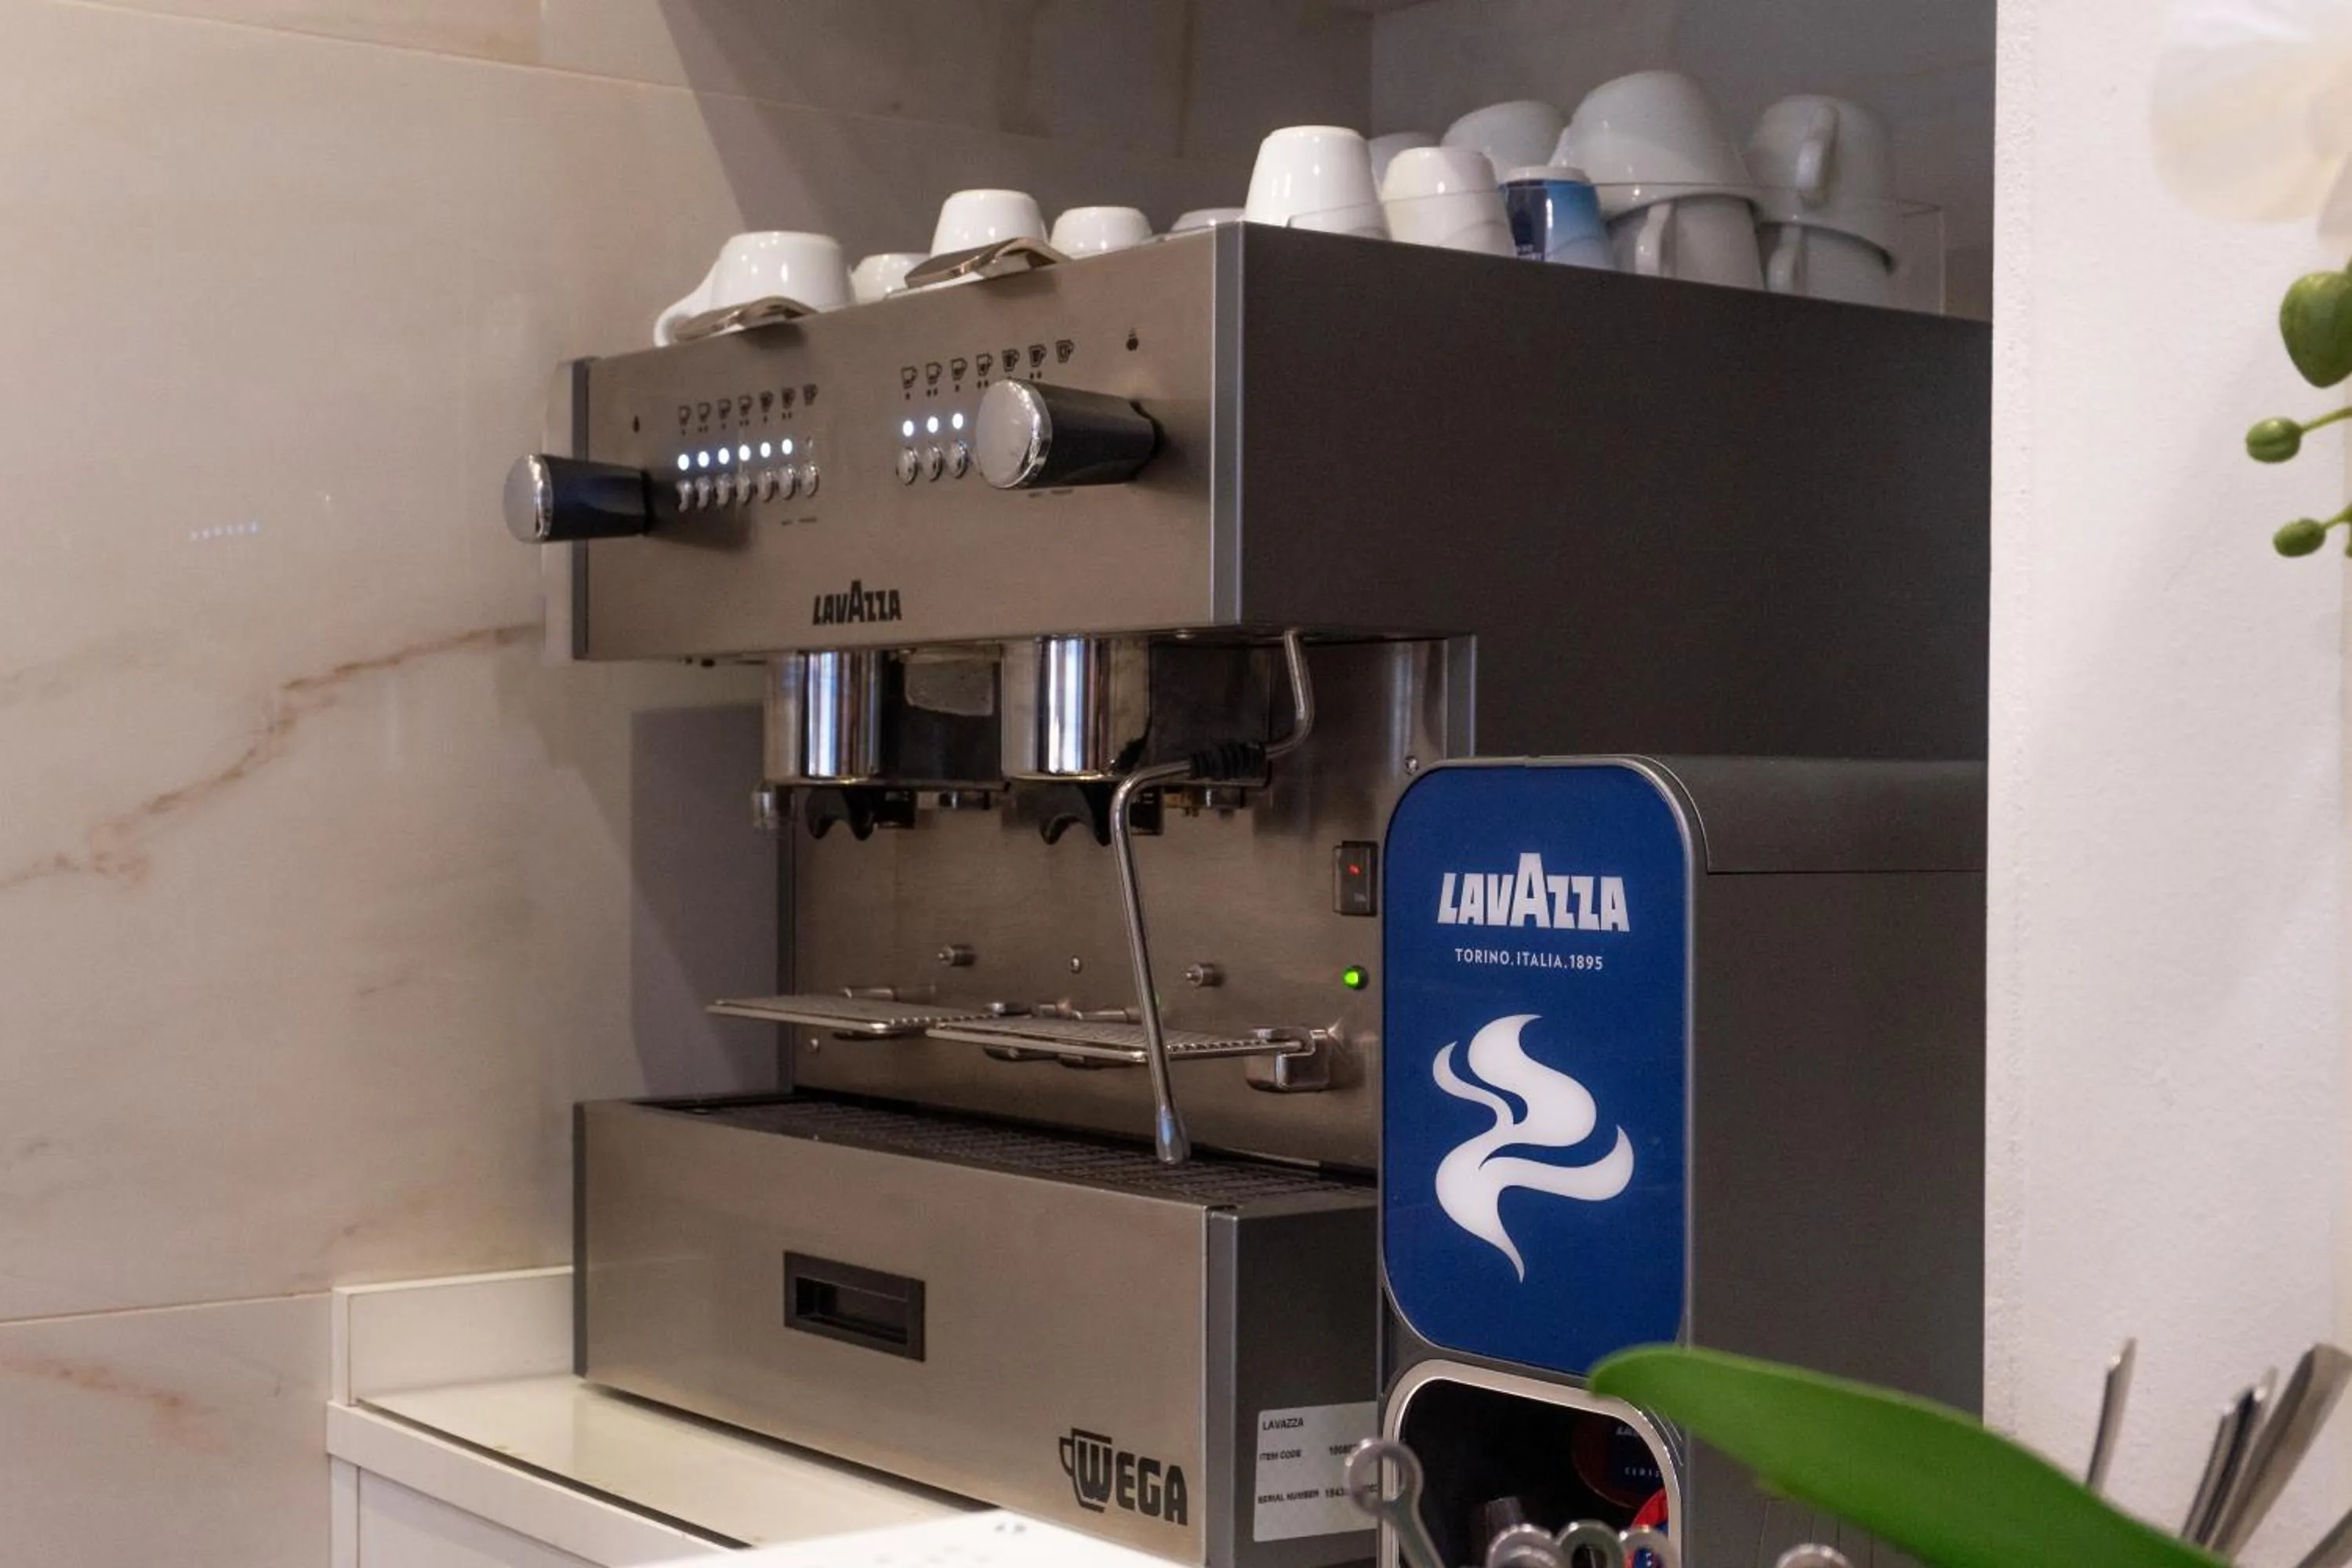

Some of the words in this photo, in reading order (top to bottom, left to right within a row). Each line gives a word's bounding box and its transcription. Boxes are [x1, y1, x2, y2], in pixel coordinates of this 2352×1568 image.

[812, 580, 902, 626] LAVAZZA
[1437, 852, 1630, 932] LAVAZZA
[1262, 1417, 1304, 1431] LAVAZZA
[1076, 1439, 1188, 1526] WEGA
